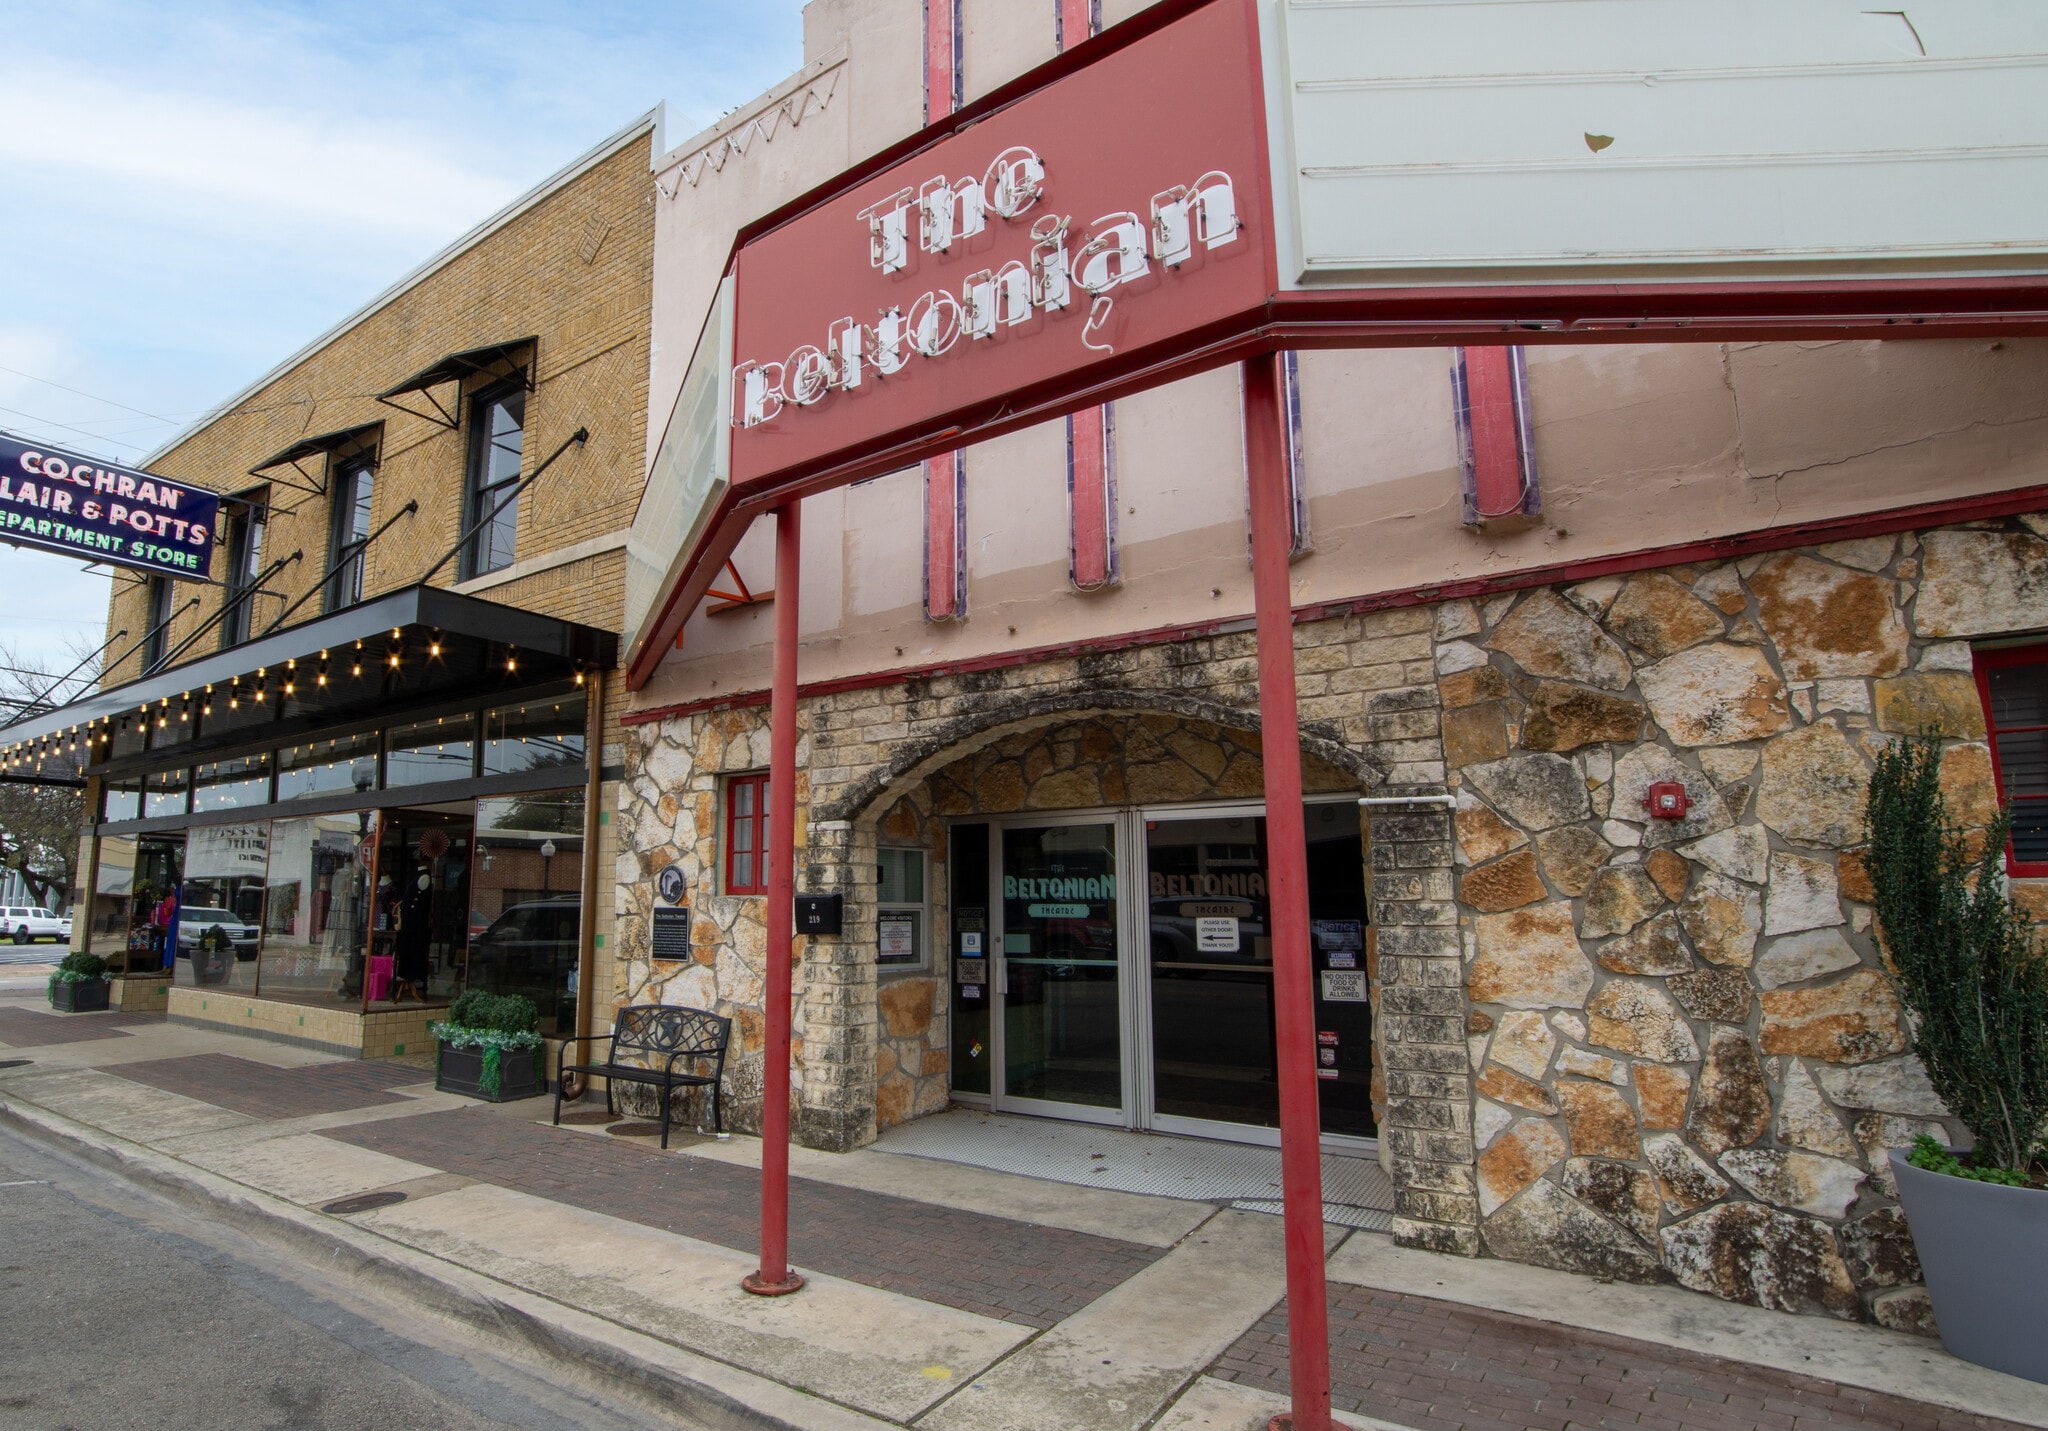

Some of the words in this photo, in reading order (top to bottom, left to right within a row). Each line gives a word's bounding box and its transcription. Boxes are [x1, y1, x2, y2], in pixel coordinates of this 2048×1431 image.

[20, 451, 179, 510] COCHRAN
[0, 476, 73, 514] LAIR
[82, 500, 101, 520] &
[109, 503, 207, 545] POTTS
[0, 510, 123, 552] EPARTMENT
[130, 541, 198, 569] STORE
[1004, 873, 1117, 899] BELTONIAN
[1150, 871, 1270, 896] BELTONIA
[1321, 922, 1357, 932] NOTICE
